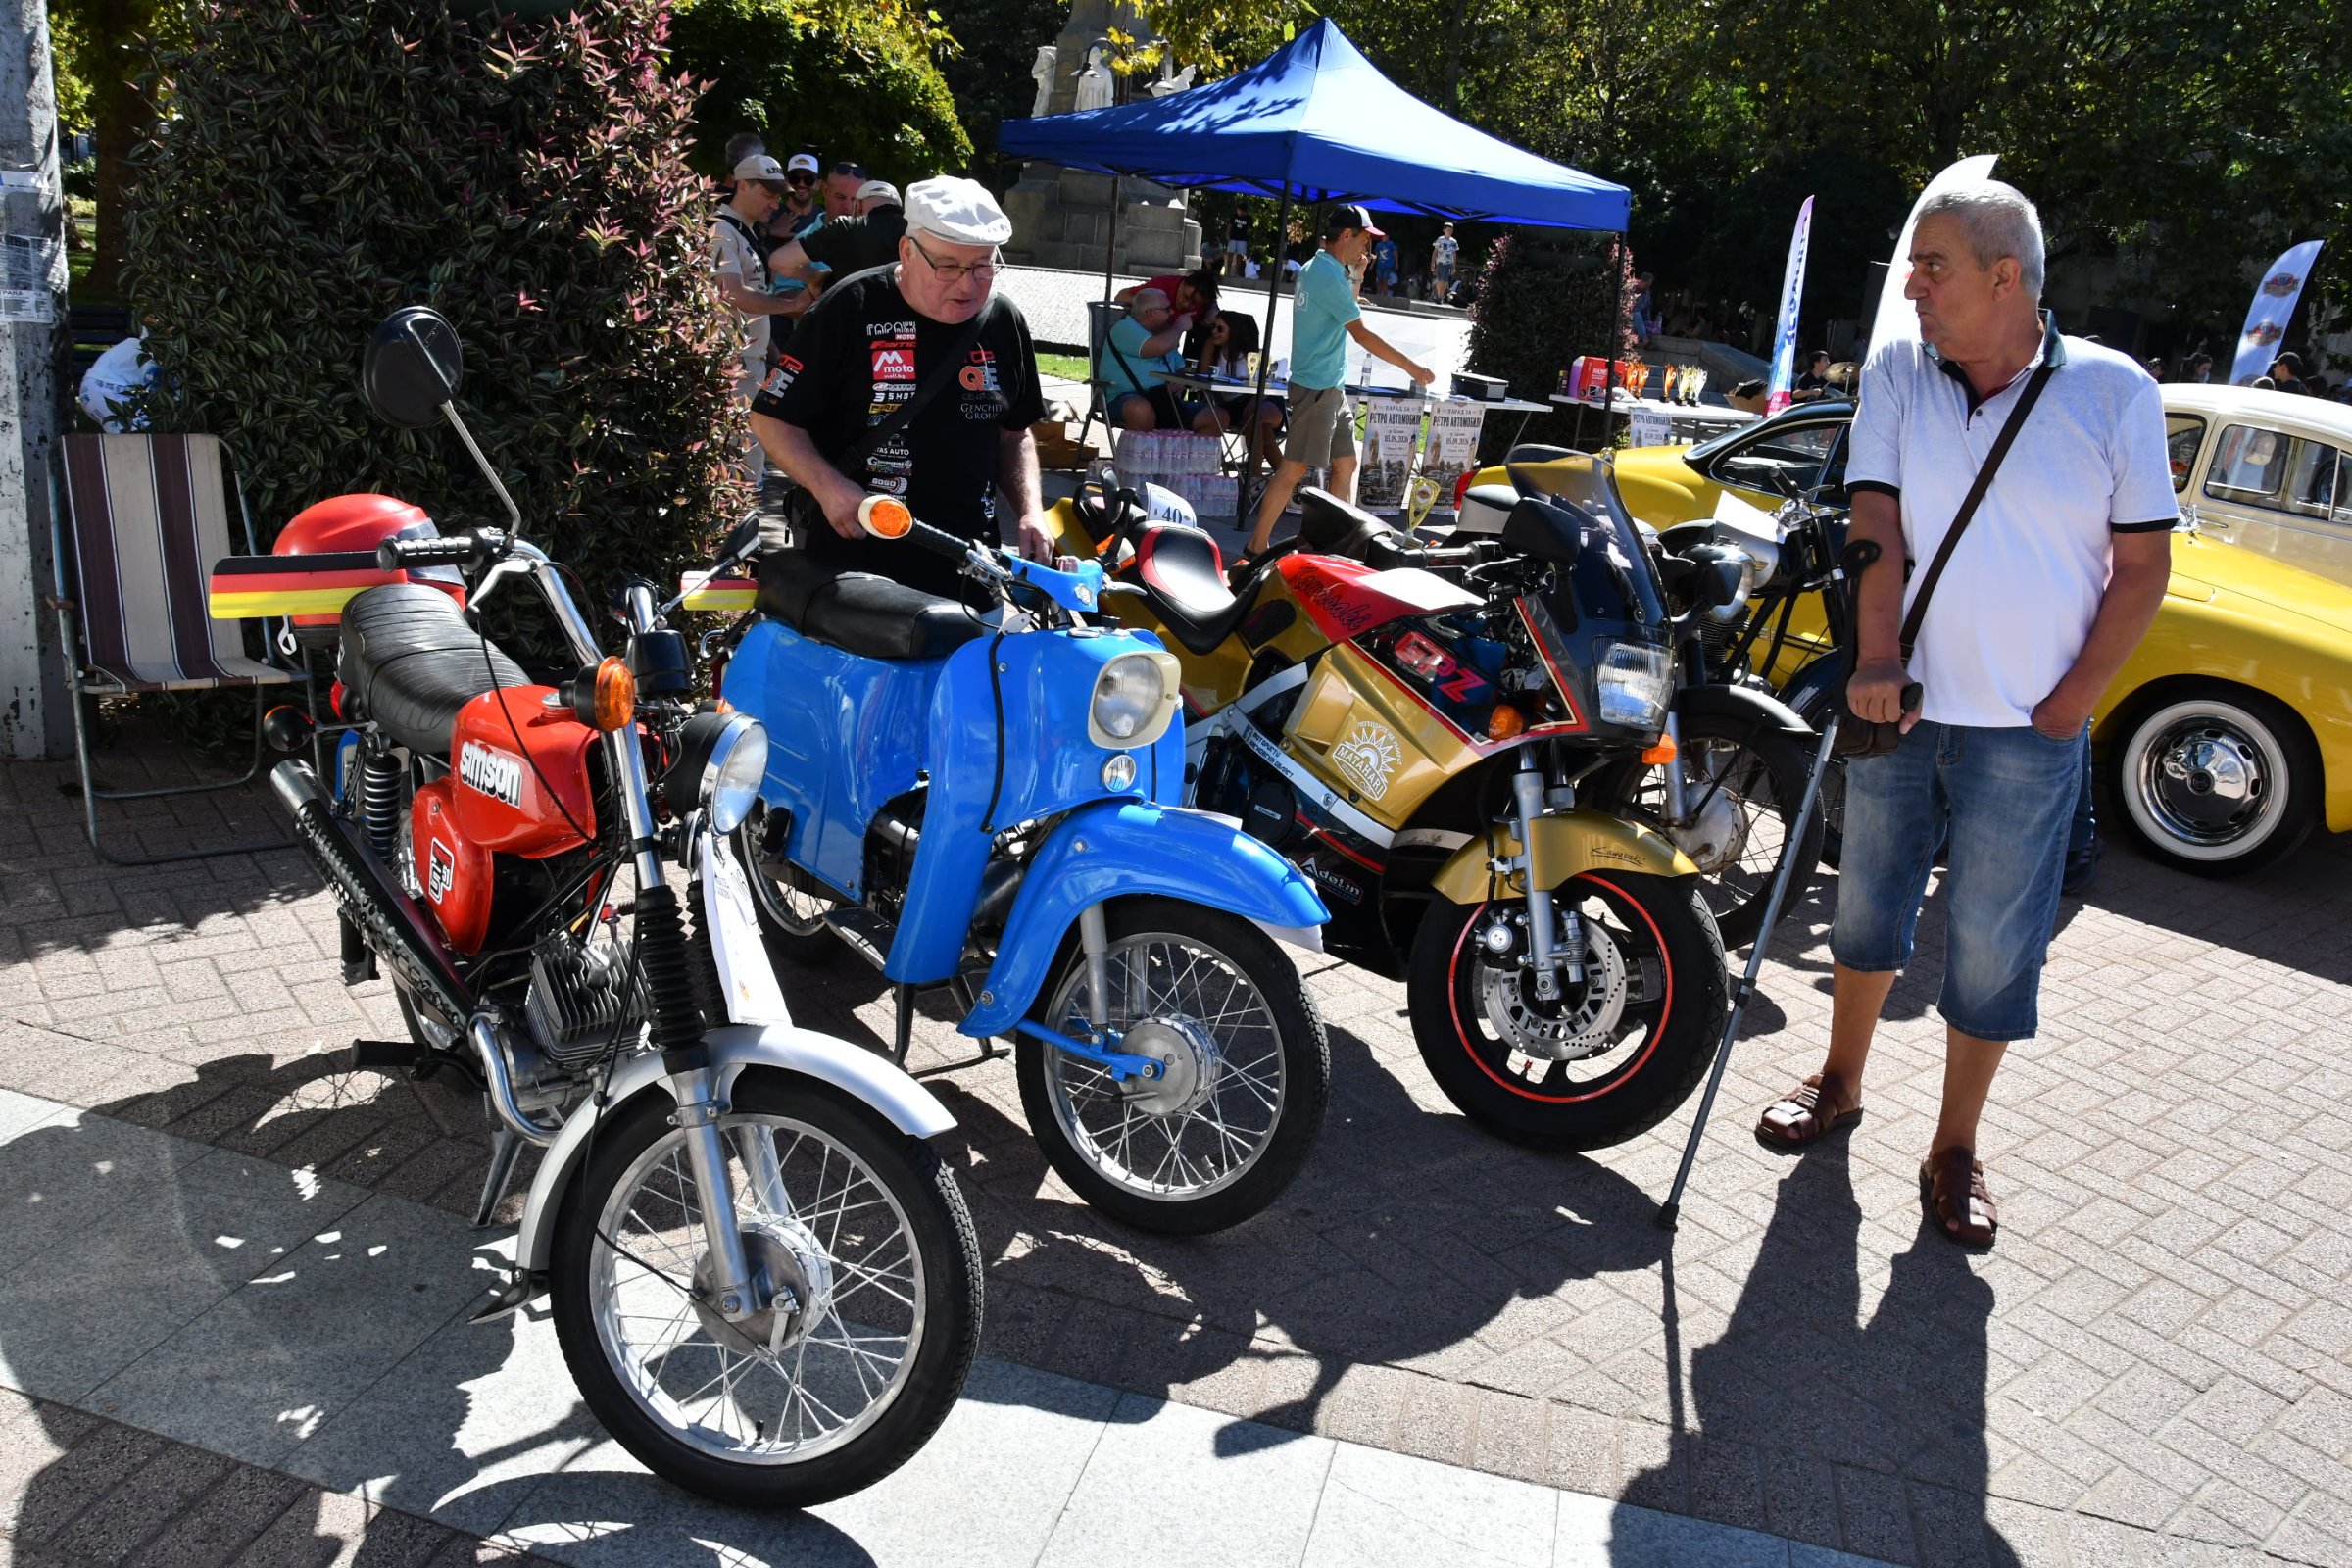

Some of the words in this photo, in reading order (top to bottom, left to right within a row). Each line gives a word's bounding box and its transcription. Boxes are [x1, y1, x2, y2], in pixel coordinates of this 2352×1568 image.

[883, 364, 914, 373] moto
[1369, 412, 1388, 424] РЕТРО
[1433, 416, 1450, 427] РЕТРО
[1162, 506, 1182, 524] 40
[460, 740, 522, 809] simson
[1336, 746, 1386, 795] MATAHARI
